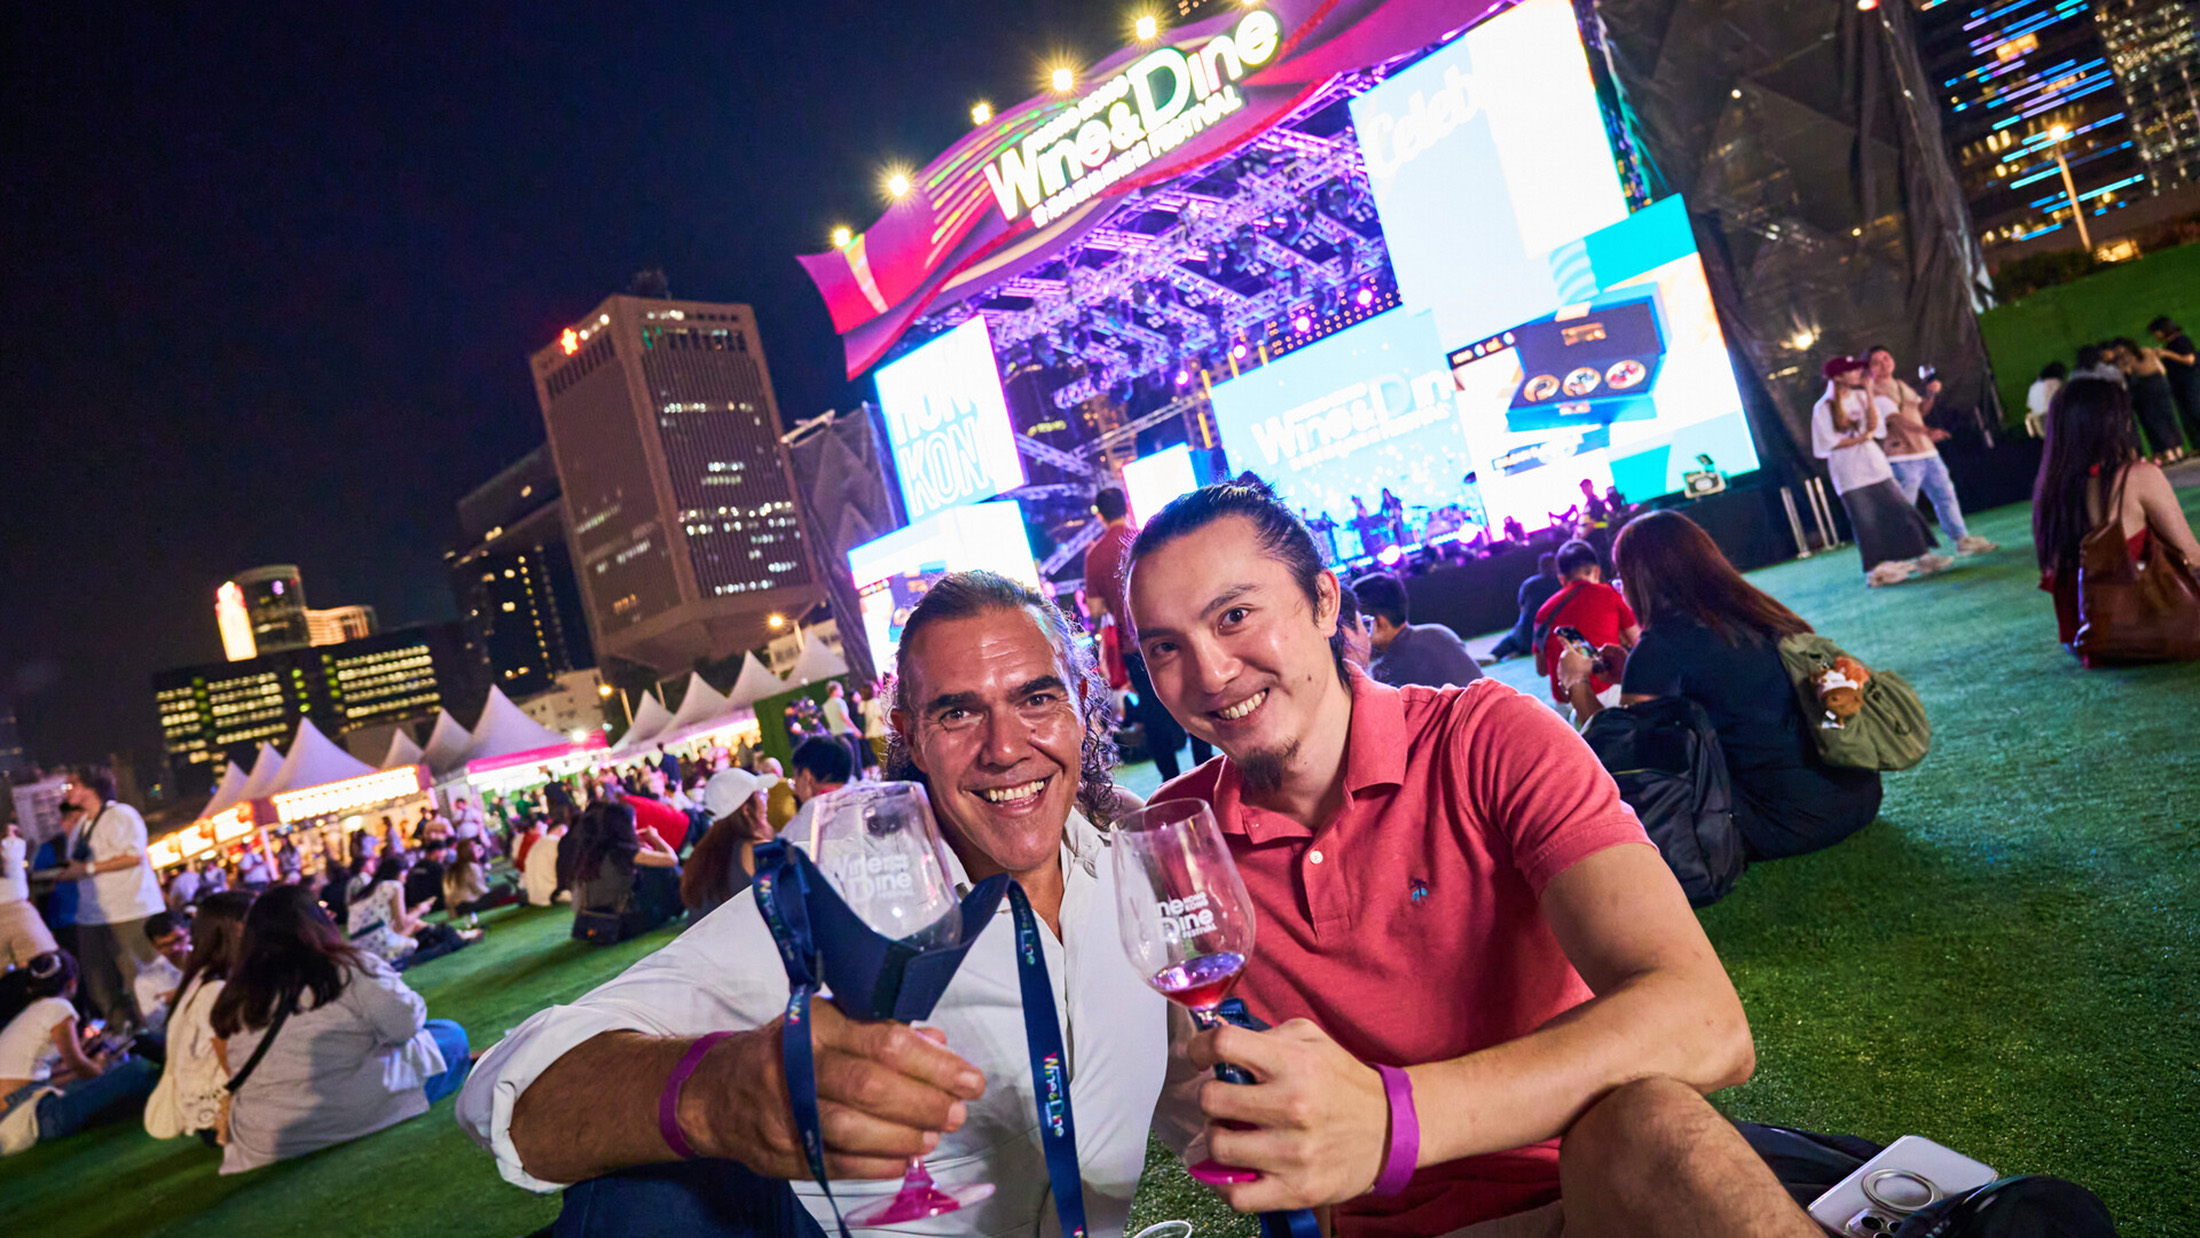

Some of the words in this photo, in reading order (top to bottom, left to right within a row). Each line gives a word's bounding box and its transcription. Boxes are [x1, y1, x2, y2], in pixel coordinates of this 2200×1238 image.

[982, 10, 1278, 221] Wine&Dine
[1250, 370, 1456, 465] Wine&Din
[898, 415, 990, 517] KON
[1160, 908, 1214, 942] Dine
[1043, 1051, 1065, 1137] Wine&Dine
